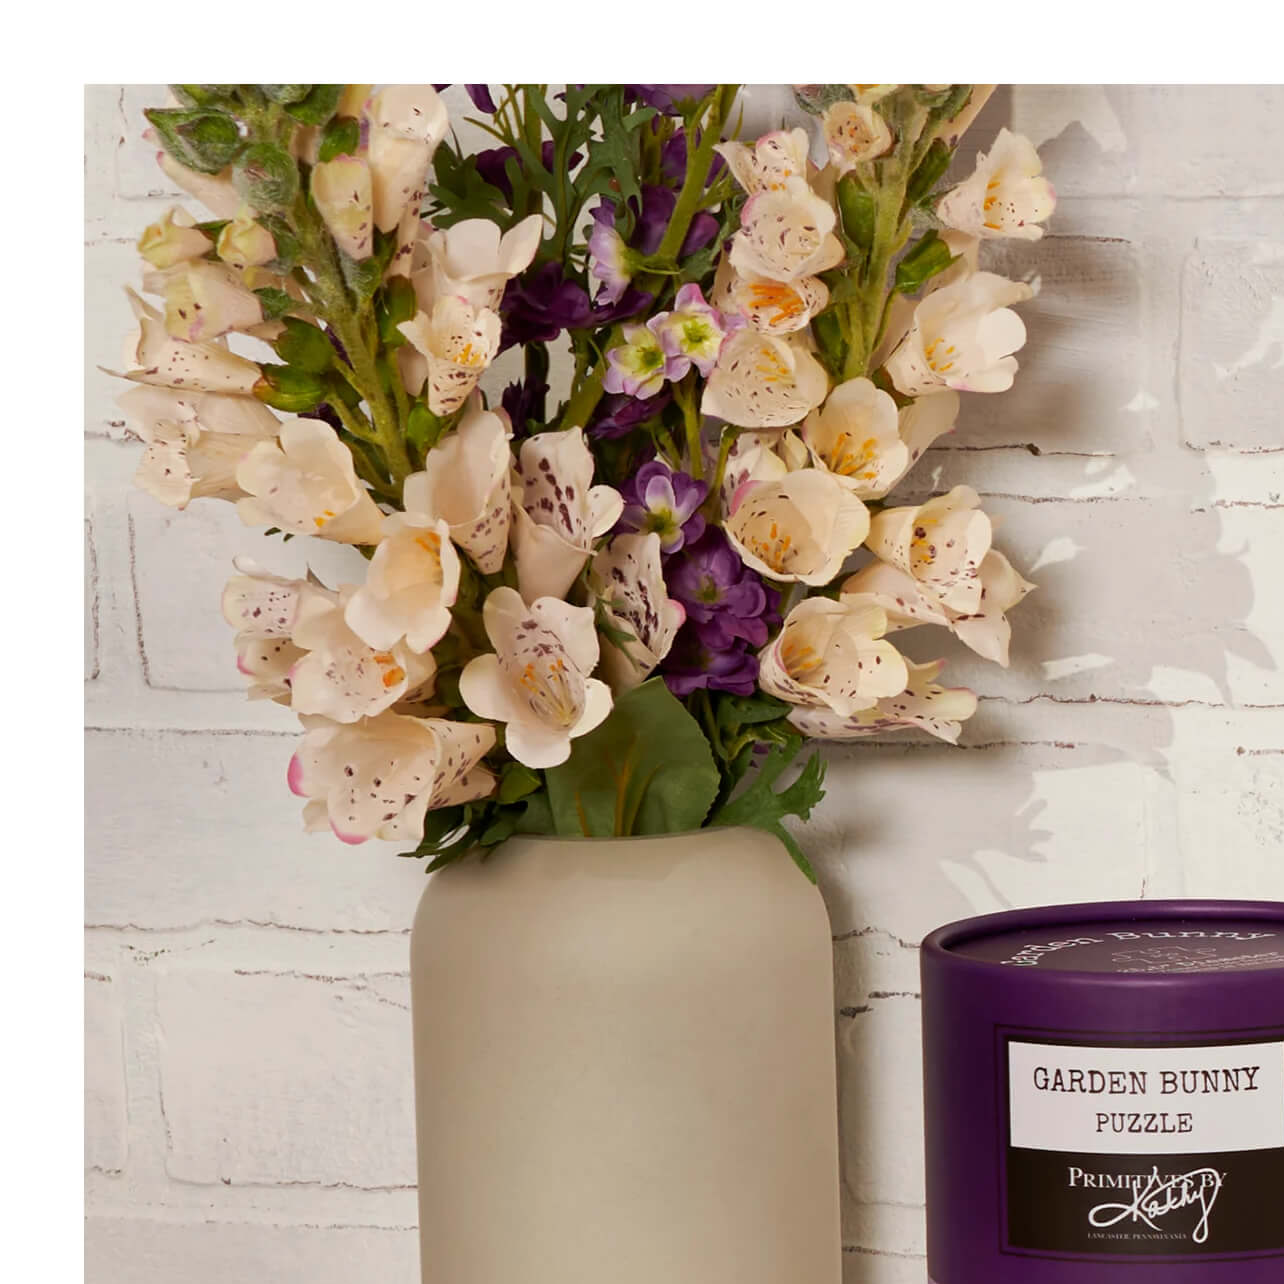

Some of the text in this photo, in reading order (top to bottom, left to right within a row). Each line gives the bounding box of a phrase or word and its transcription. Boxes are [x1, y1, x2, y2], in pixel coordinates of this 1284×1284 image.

[1107, 930, 1277, 940] Bunny
[1033, 1066, 1260, 1095] GARDEN BUNNY
[1095, 1112, 1193, 1133] PUZZLE
[1088, 1165, 1220, 1244] Kathy
